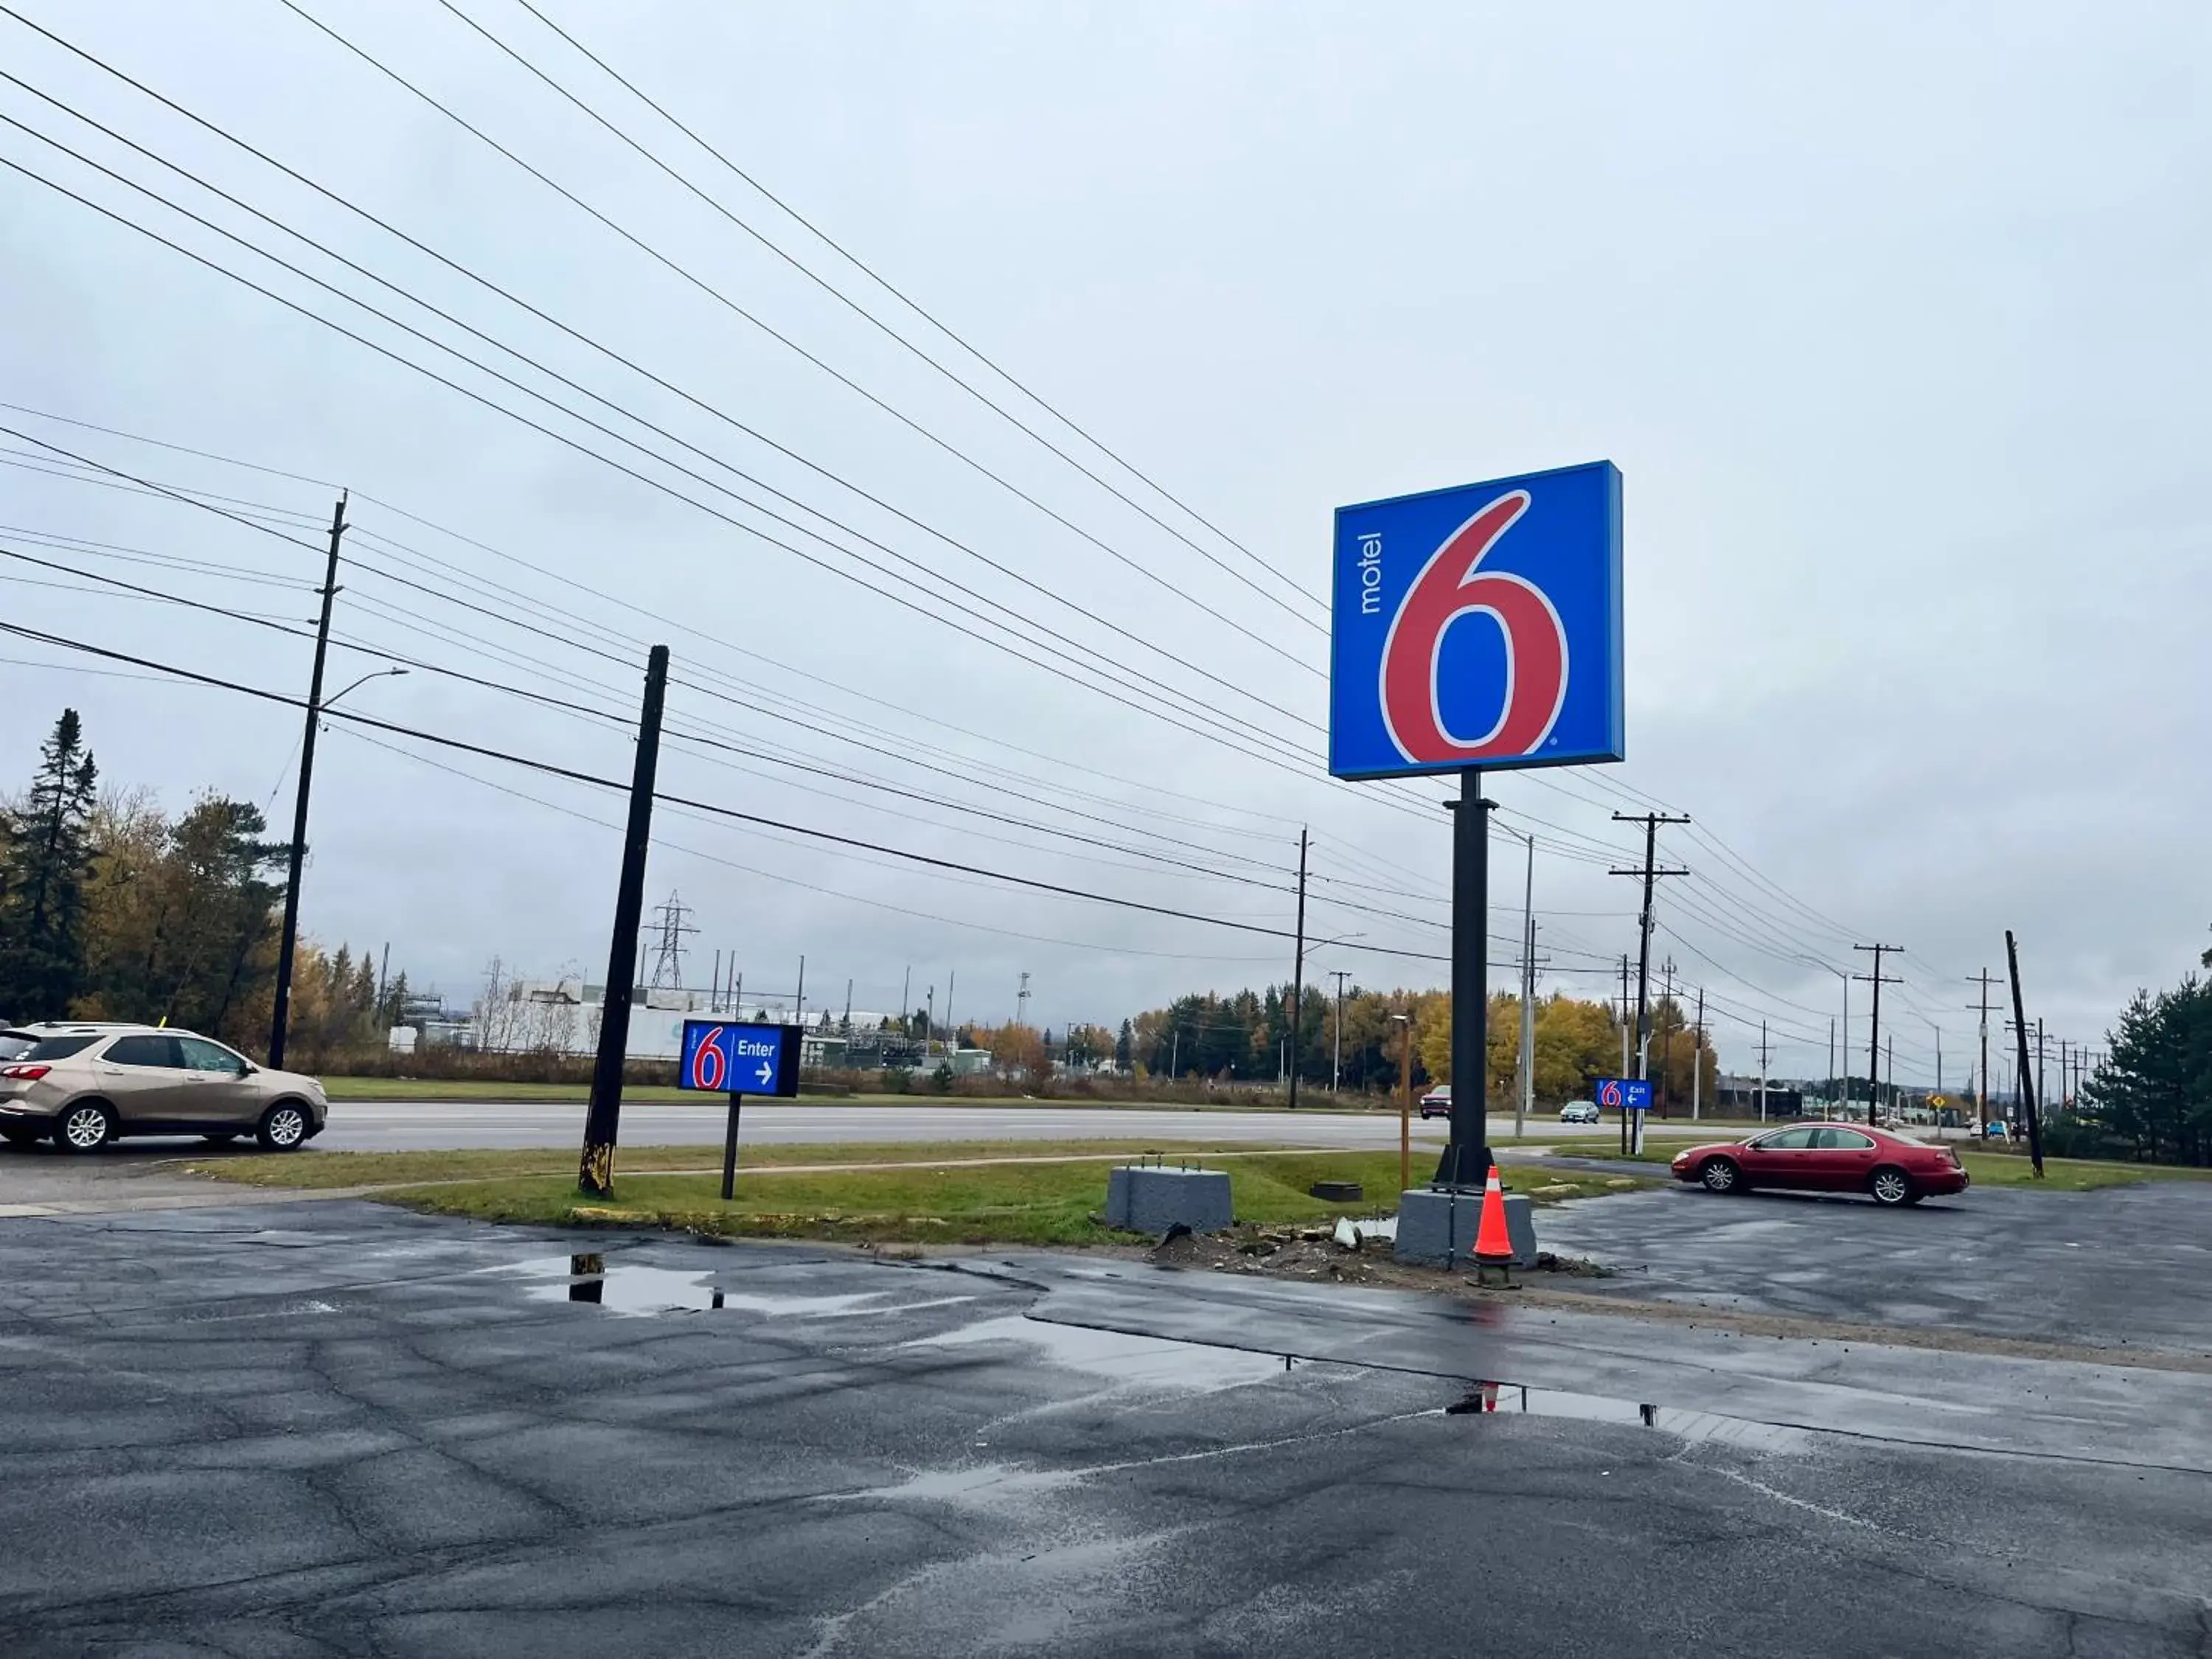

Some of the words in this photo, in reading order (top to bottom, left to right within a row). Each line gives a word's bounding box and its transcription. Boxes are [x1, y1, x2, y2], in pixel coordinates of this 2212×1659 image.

[1357, 532, 1381, 614] motel
[1379, 489, 1570, 764] 6
[693, 1026, 726, 1090] 6
[738, 1040, 776, 1057] Enter
[1601, 1080, 1621, 1107] 6
